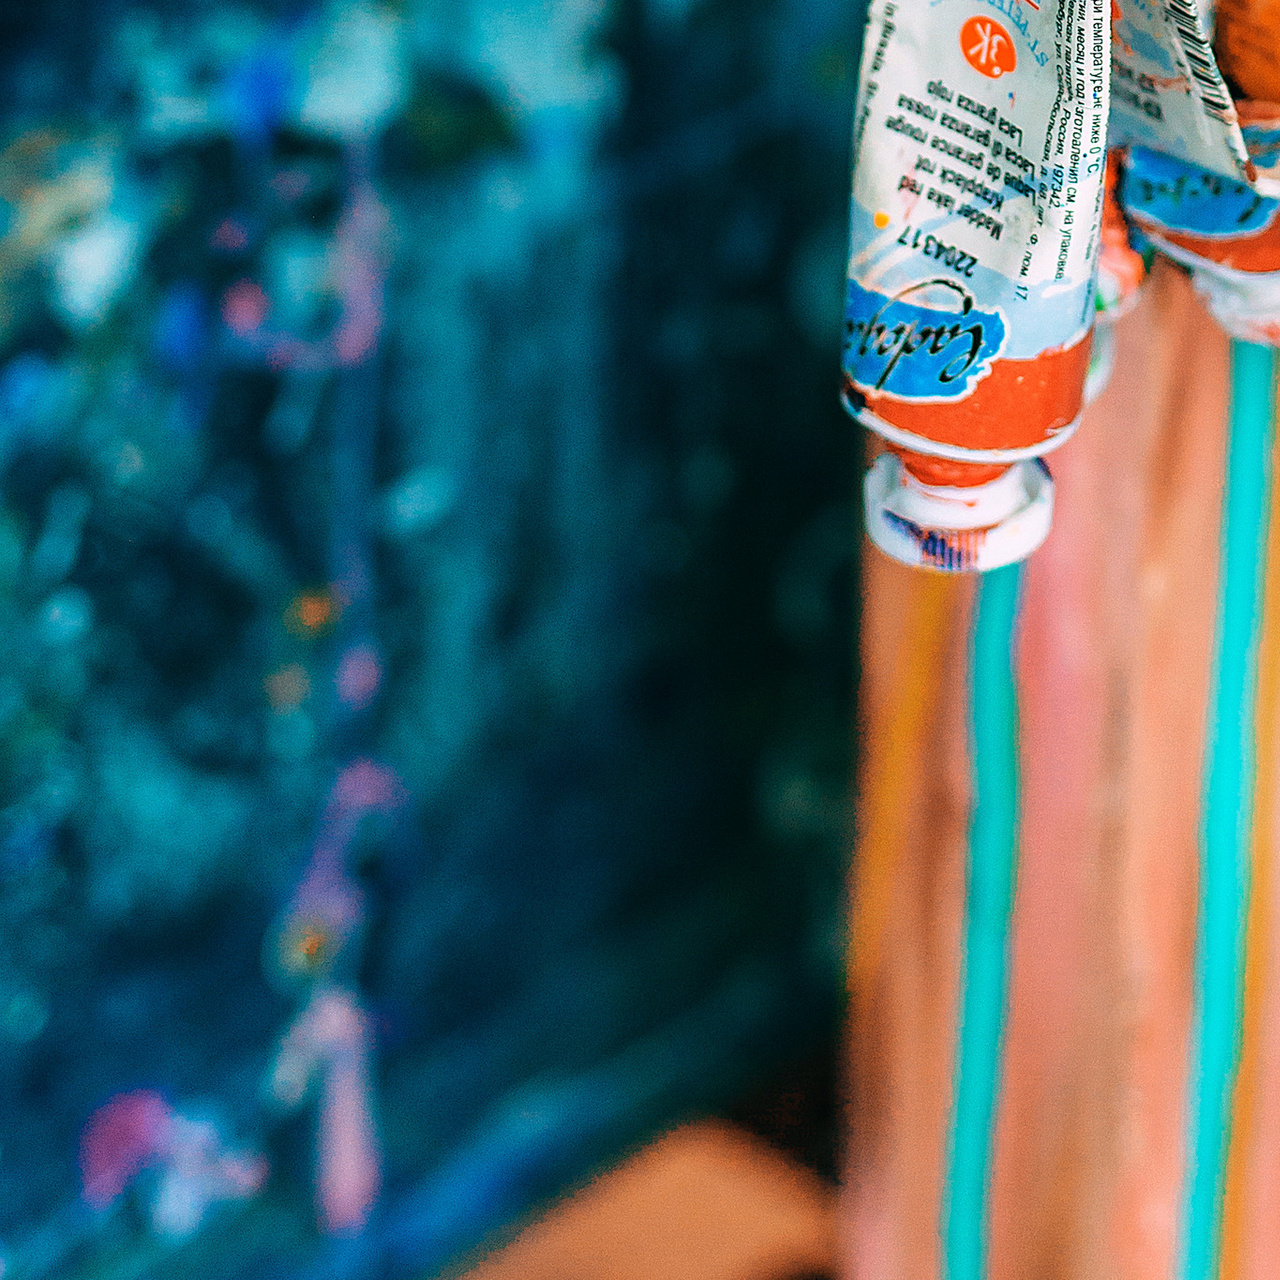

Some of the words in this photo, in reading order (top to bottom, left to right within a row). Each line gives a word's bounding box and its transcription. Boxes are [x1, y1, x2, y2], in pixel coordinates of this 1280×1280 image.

[1072, 25, 1086, 64] месяц
[1075, 66, 1085, 76] и
[1089, 112, 1103, 144] ниже
[983, 161, 1002, 184] de
[896, 174, 923, 201] red
[924, 186, 957, 215] lake
[955, 201, 1004, 241] Madder
[1062, 209, 1074, 225] на
[896, 225, 977, 279] 2204317
